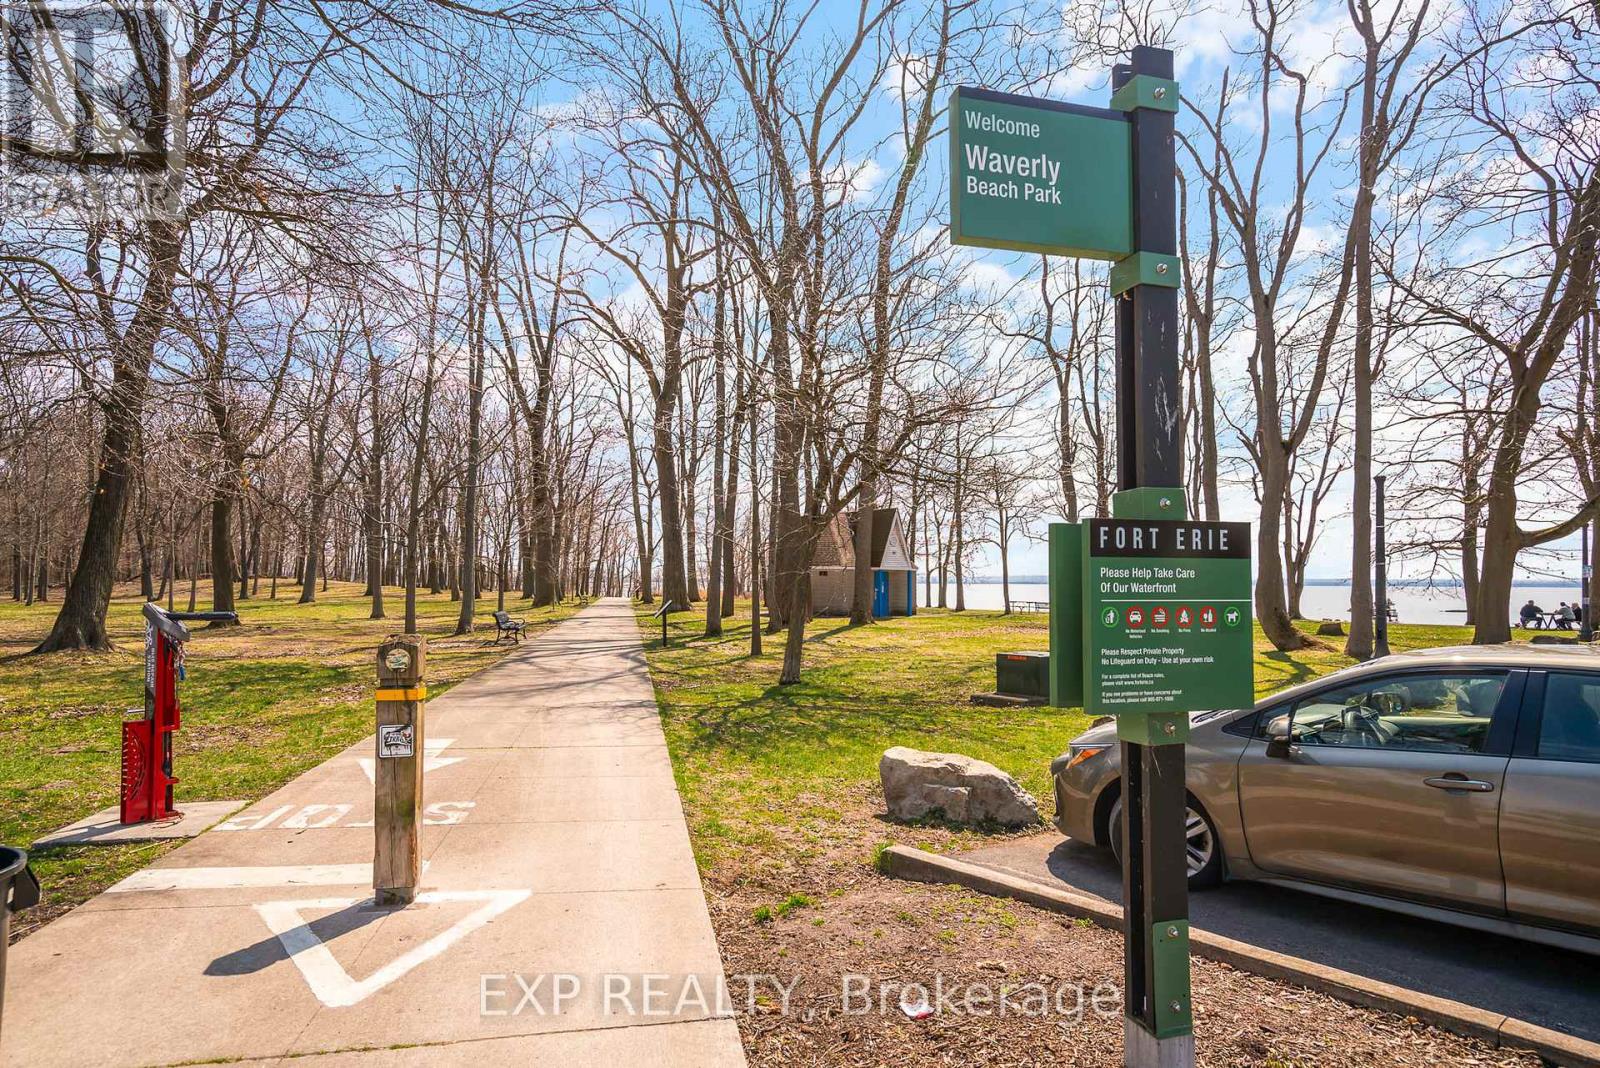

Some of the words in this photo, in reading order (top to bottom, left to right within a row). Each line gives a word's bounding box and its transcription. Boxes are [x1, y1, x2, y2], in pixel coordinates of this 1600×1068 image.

[964, 109, 1040, 138] Welcome
[964, 143, 1061, 186] Waverly
[966, 175, 1019, 200] Beach
[1024, 182, 1062, 205] Park
[1099, 526, 1159, 550] FORT
[1176, 527, 1229, 551] ERIE
[1100, 567, 1130, 579] Please
[1131, 567, 1152, 580] Help
[1153, 567, 1174, 579] Take
[1175, 567, 1196, 578] Care
[1100, 582, 1112, 594] Of
[1113, 582, 1129, 594] Our
[1131, 582, 1177, 594] Waterfront
[1101, 648, 1120, 656] Please
[1120, 648, 1142, 657] Respect
[1110, 657, 1136, 666] Lifeguard
[1144, 657, 1157, 665] Duty
[1179, 657, 1191, 665] your
[210, 801, 477, 831] SOP
